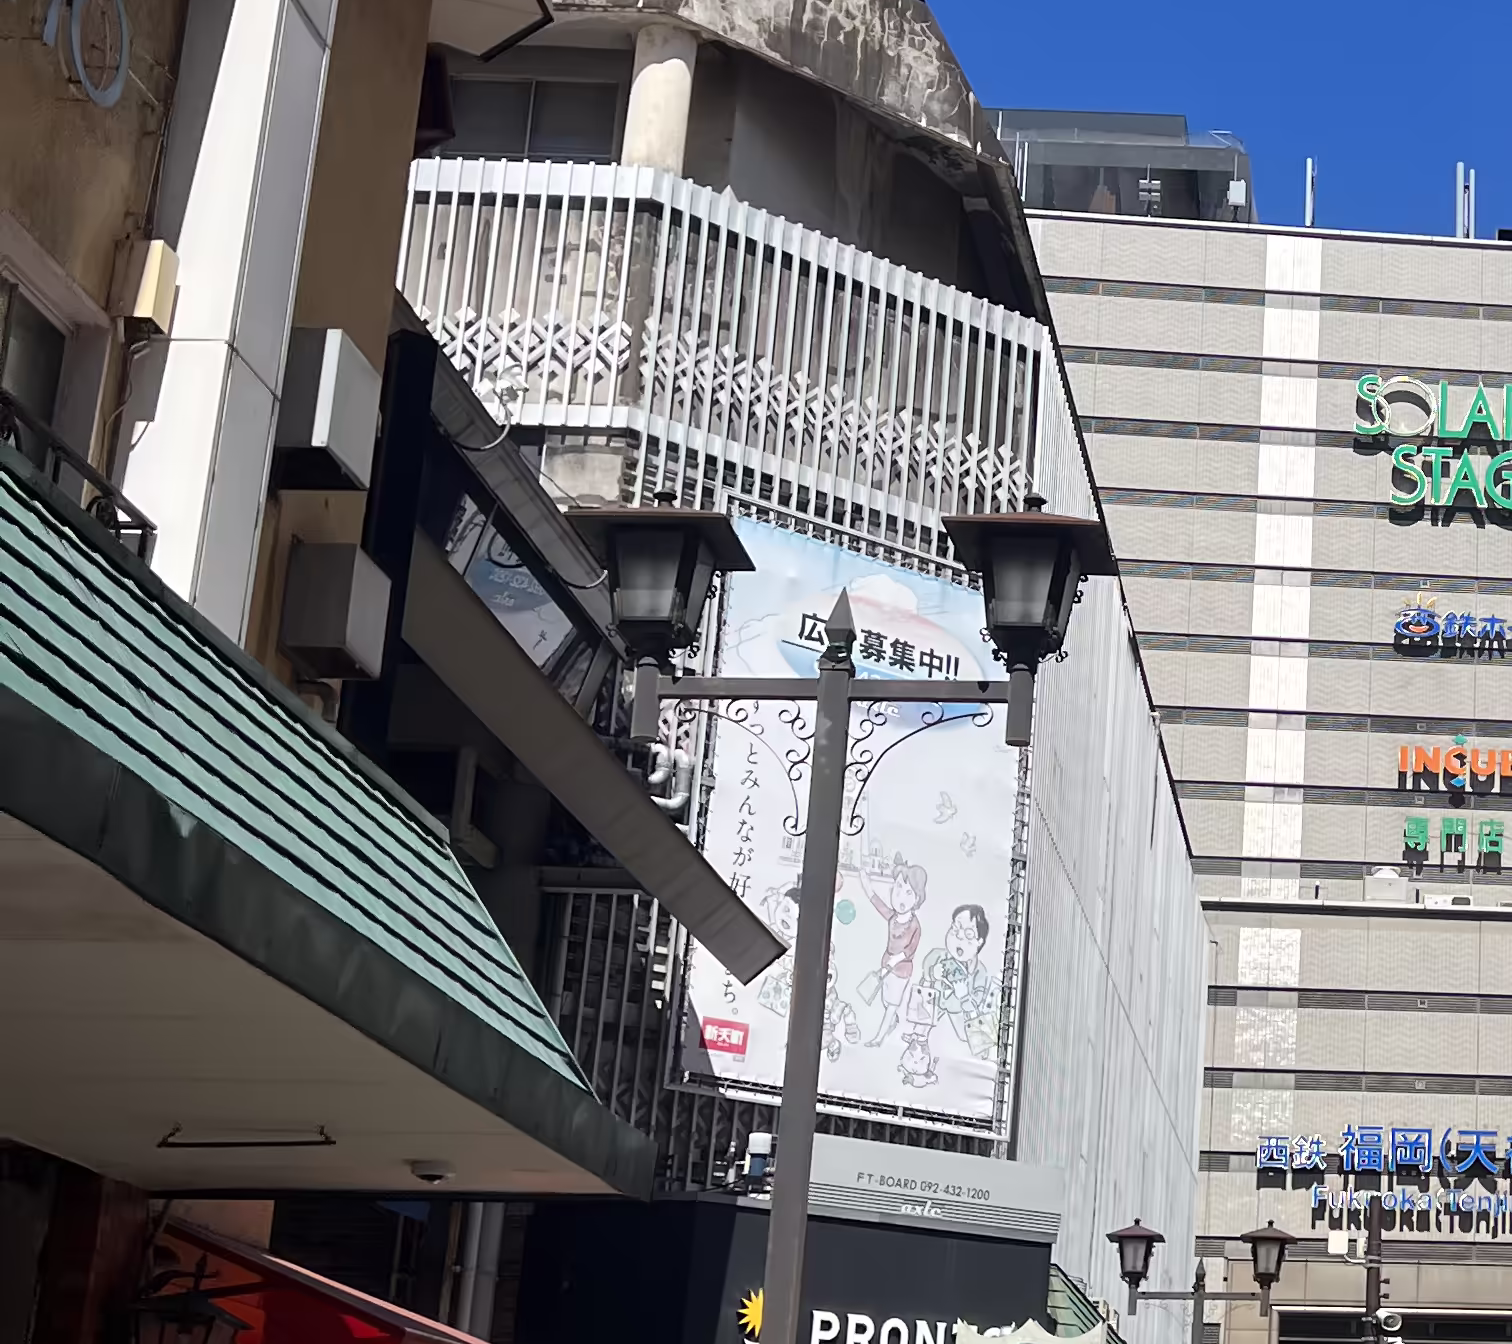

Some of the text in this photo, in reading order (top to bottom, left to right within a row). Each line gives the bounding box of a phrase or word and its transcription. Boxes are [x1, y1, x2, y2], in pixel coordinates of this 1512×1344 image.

[798, 612, 961, 682] 広募集中!!
[1256, 1133, 1328, 1171] 西鉄
[919, 1180, 991, 1201] 092-432-1200
